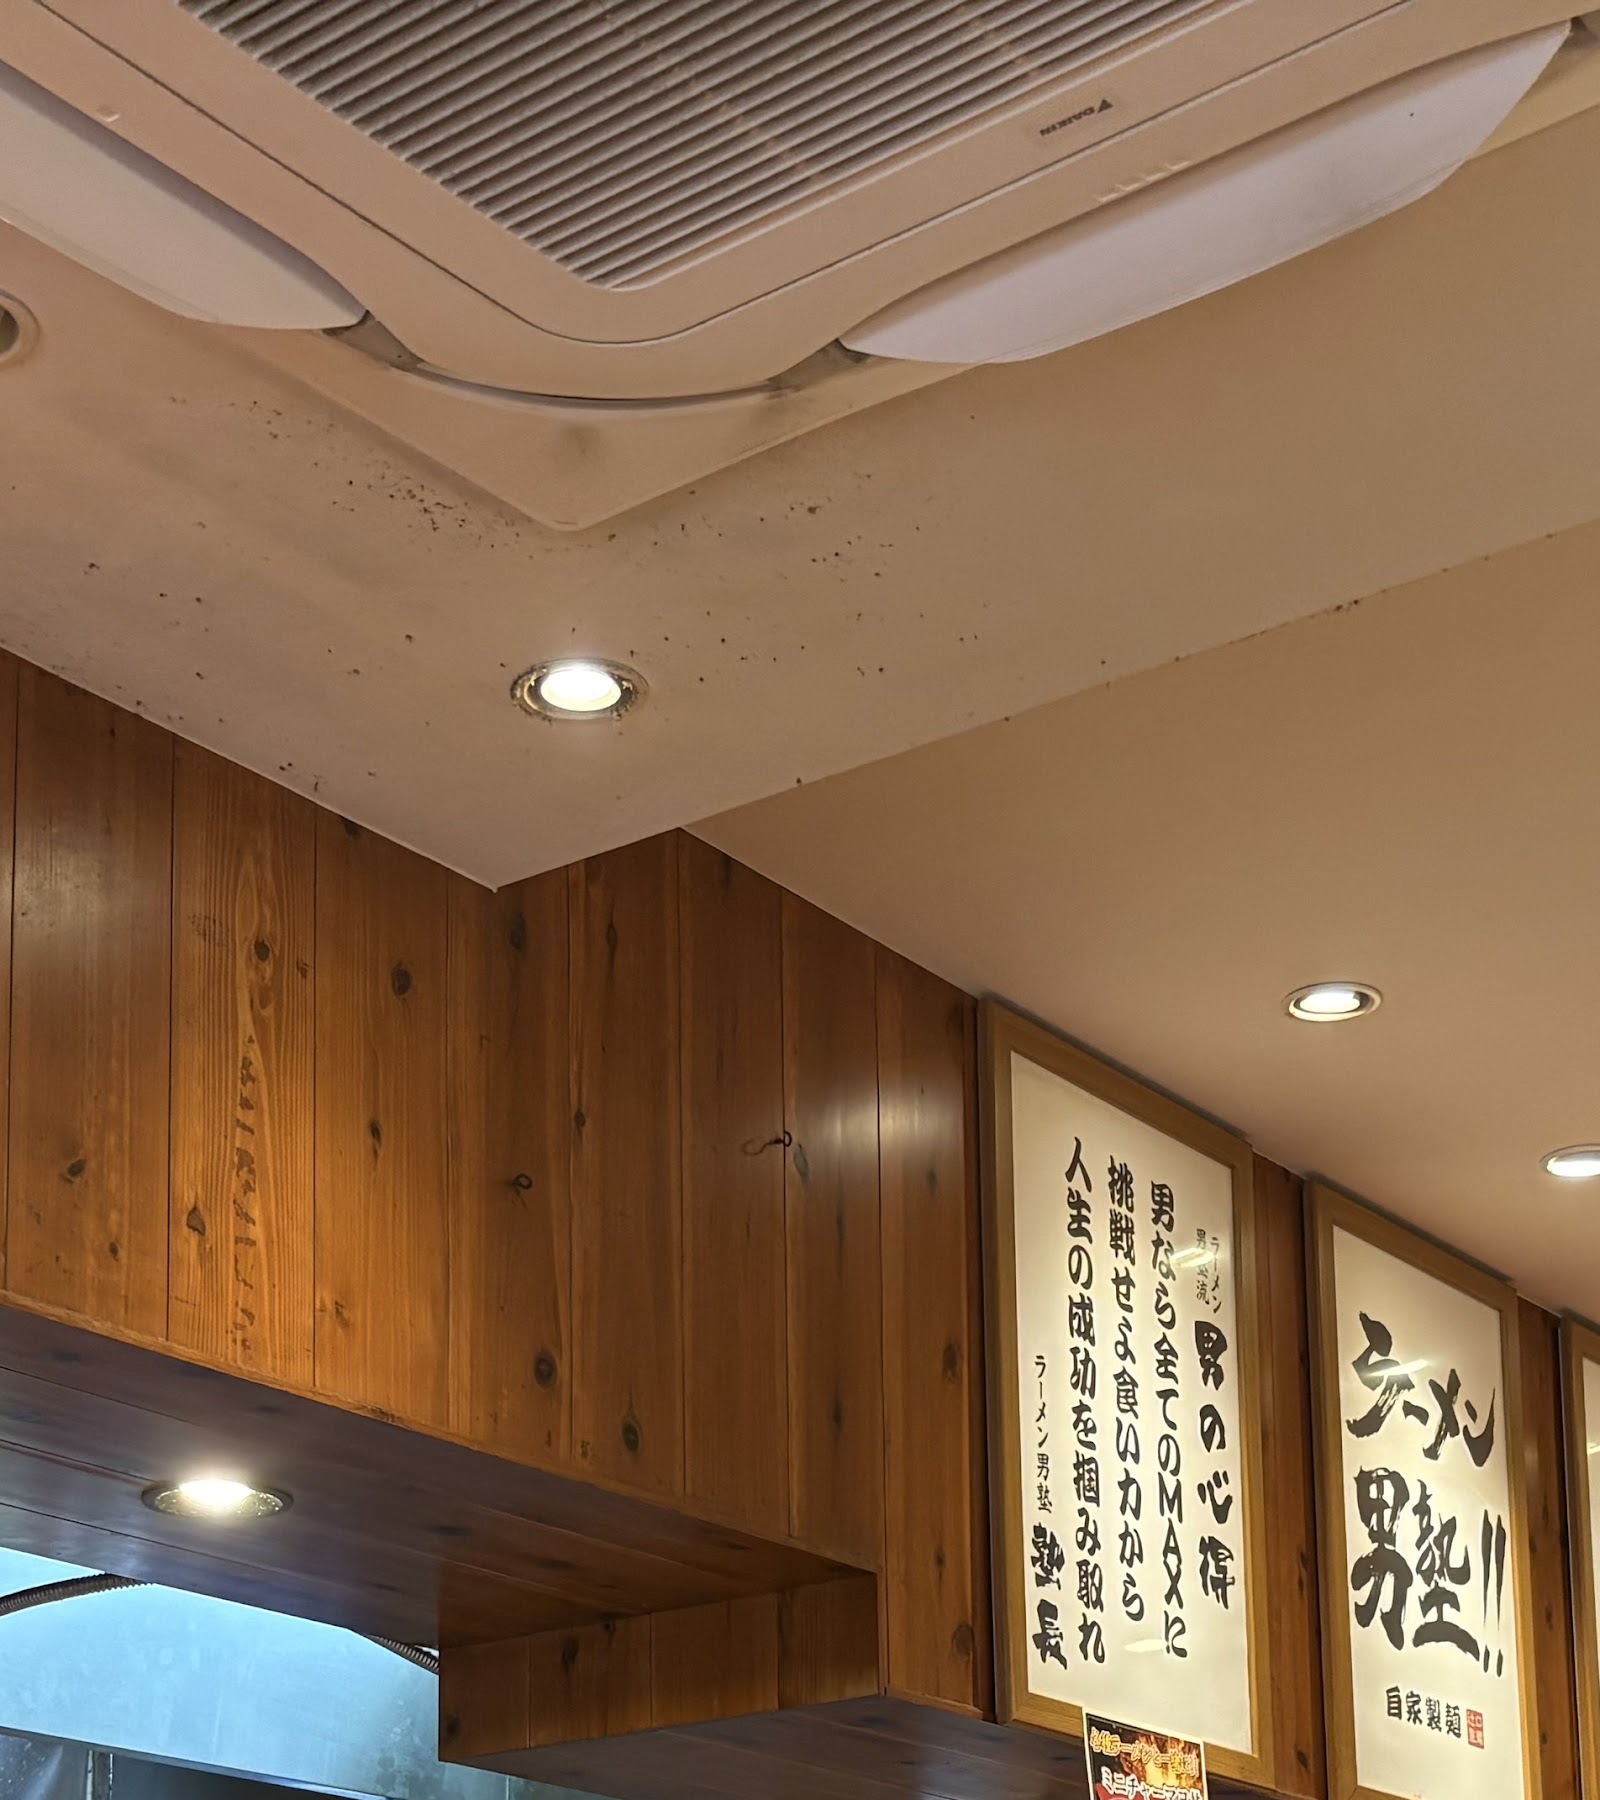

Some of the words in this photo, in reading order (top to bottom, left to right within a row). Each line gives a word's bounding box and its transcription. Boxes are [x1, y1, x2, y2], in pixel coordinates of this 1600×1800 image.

[1065, 1136, 1105, 1664] 人生の成功を掴み取れ
[1150, 1180, 1187, 1658] 男なら全てのMAXに
[1195, 1320, 1235, 1610] 男の心得
[1346, 1310, 1496, 1467] ラーメン
